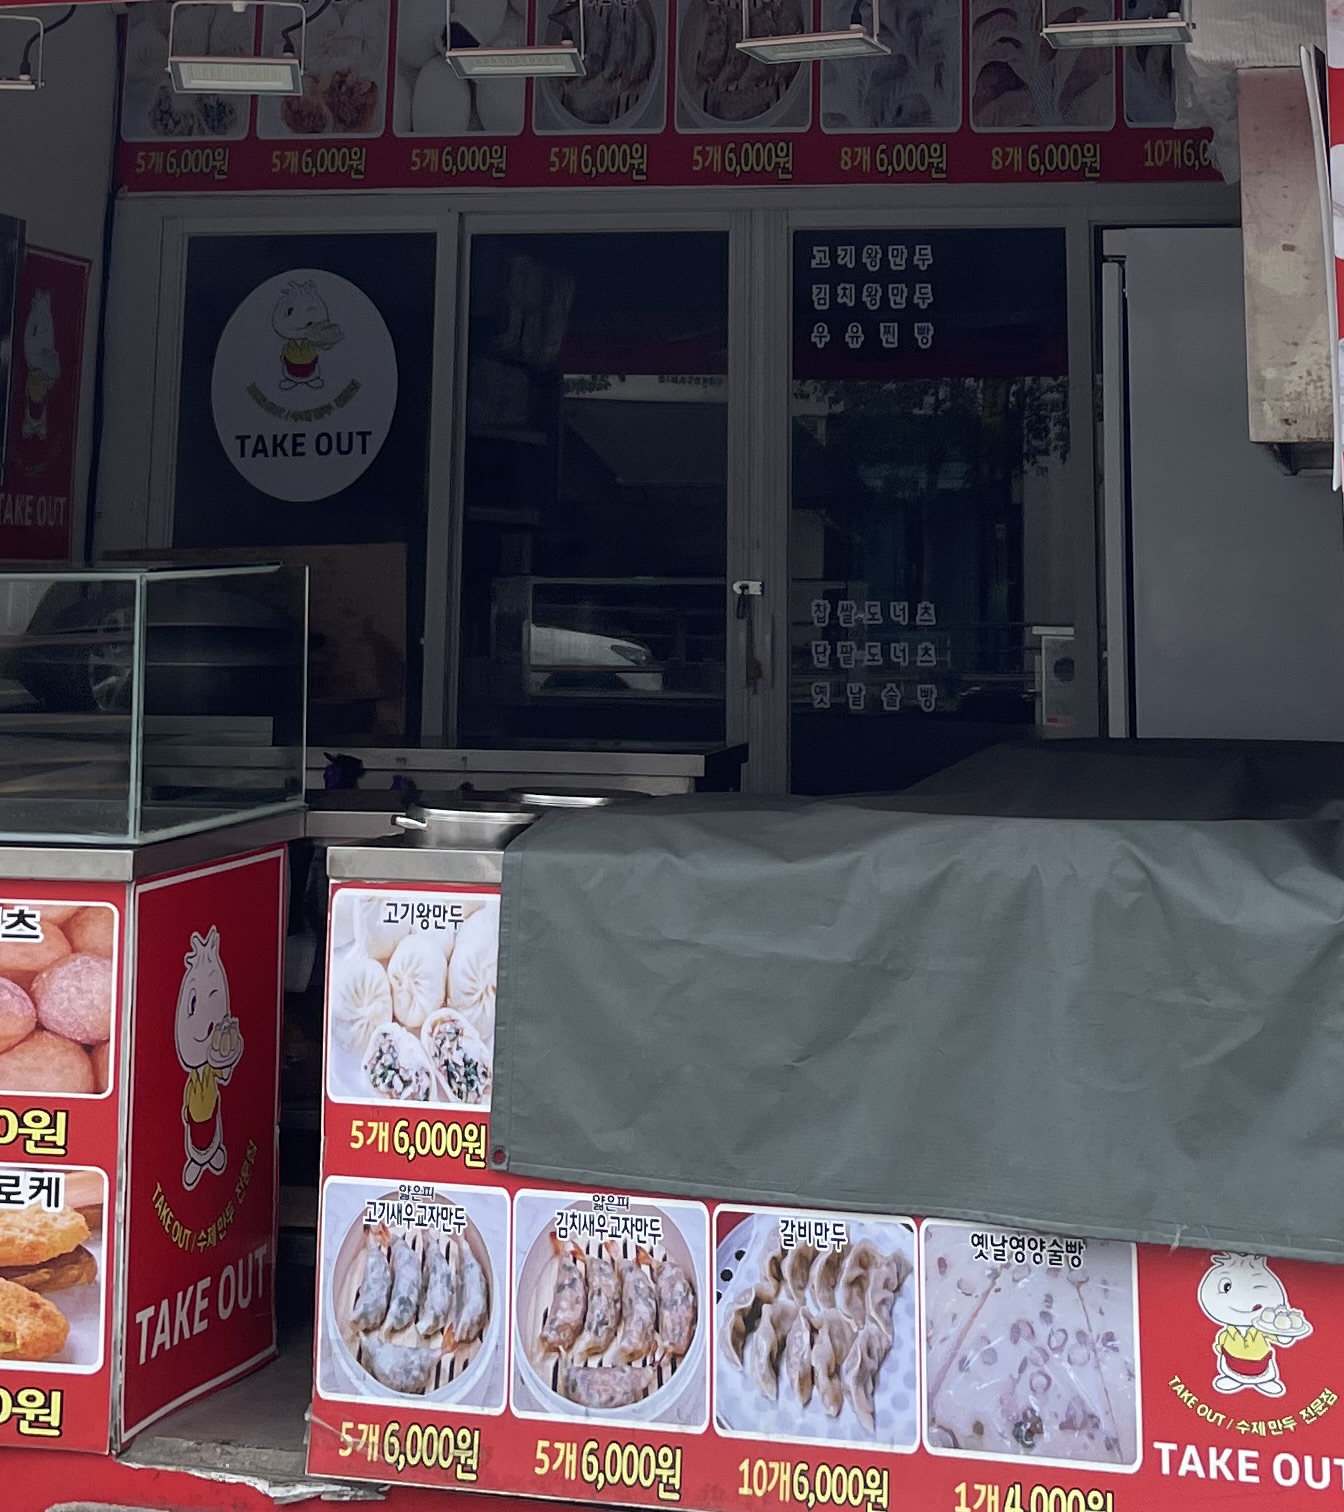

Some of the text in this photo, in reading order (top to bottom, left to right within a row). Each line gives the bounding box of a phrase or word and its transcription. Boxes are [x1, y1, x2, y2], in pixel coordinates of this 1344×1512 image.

[136, 147, 229, 180] 5개 6,000원
[271, 147, 366, 180] 5개 6,000원
[411, 144, 507, 178] 5개 6,000원
[549, 143, 648, 180] 5개 6,000원
[692, 141, 793, 179] 5개 6,000원
[839, 143, 947, 179] 8개 6,000원
[991, 142, 1101, 179] 8개 6,000원
[1144, 139, 1182, 168] 10개
[235, 431, 373, 458] TAKE OUT
[35, 495, 69, 528] OUT
[383, 902, 464, 930] 고기왕만두
[350, 1120, 487, 1168] 5개 6,000원
[398, 1184, 435, 1200] 얇은피
[592, 1194, 630, 1210] 얇은피
[364, 1201, 467, 1234] 고기새우교자만두
[556, 1211, 663, 1244] 김치새우교자만두
[780, 1217, 847, 1250] 갈비만두
[970, 1232, 1086, 1270] 옛날영양술빵
[136, 1243, 268, 1365] TAKE OUT
[1168, 1375, 1340, 1437] TAKE OUT 수제만두 전문점
[339, 1420, 481, 1480] 5개 6,000원
[1153, 1441, 1261, 1484] TAKE
[534, 1441, 683, 1501] 5개 6,000원
[738, 1458, 889, 1511] 10개 6,000원
